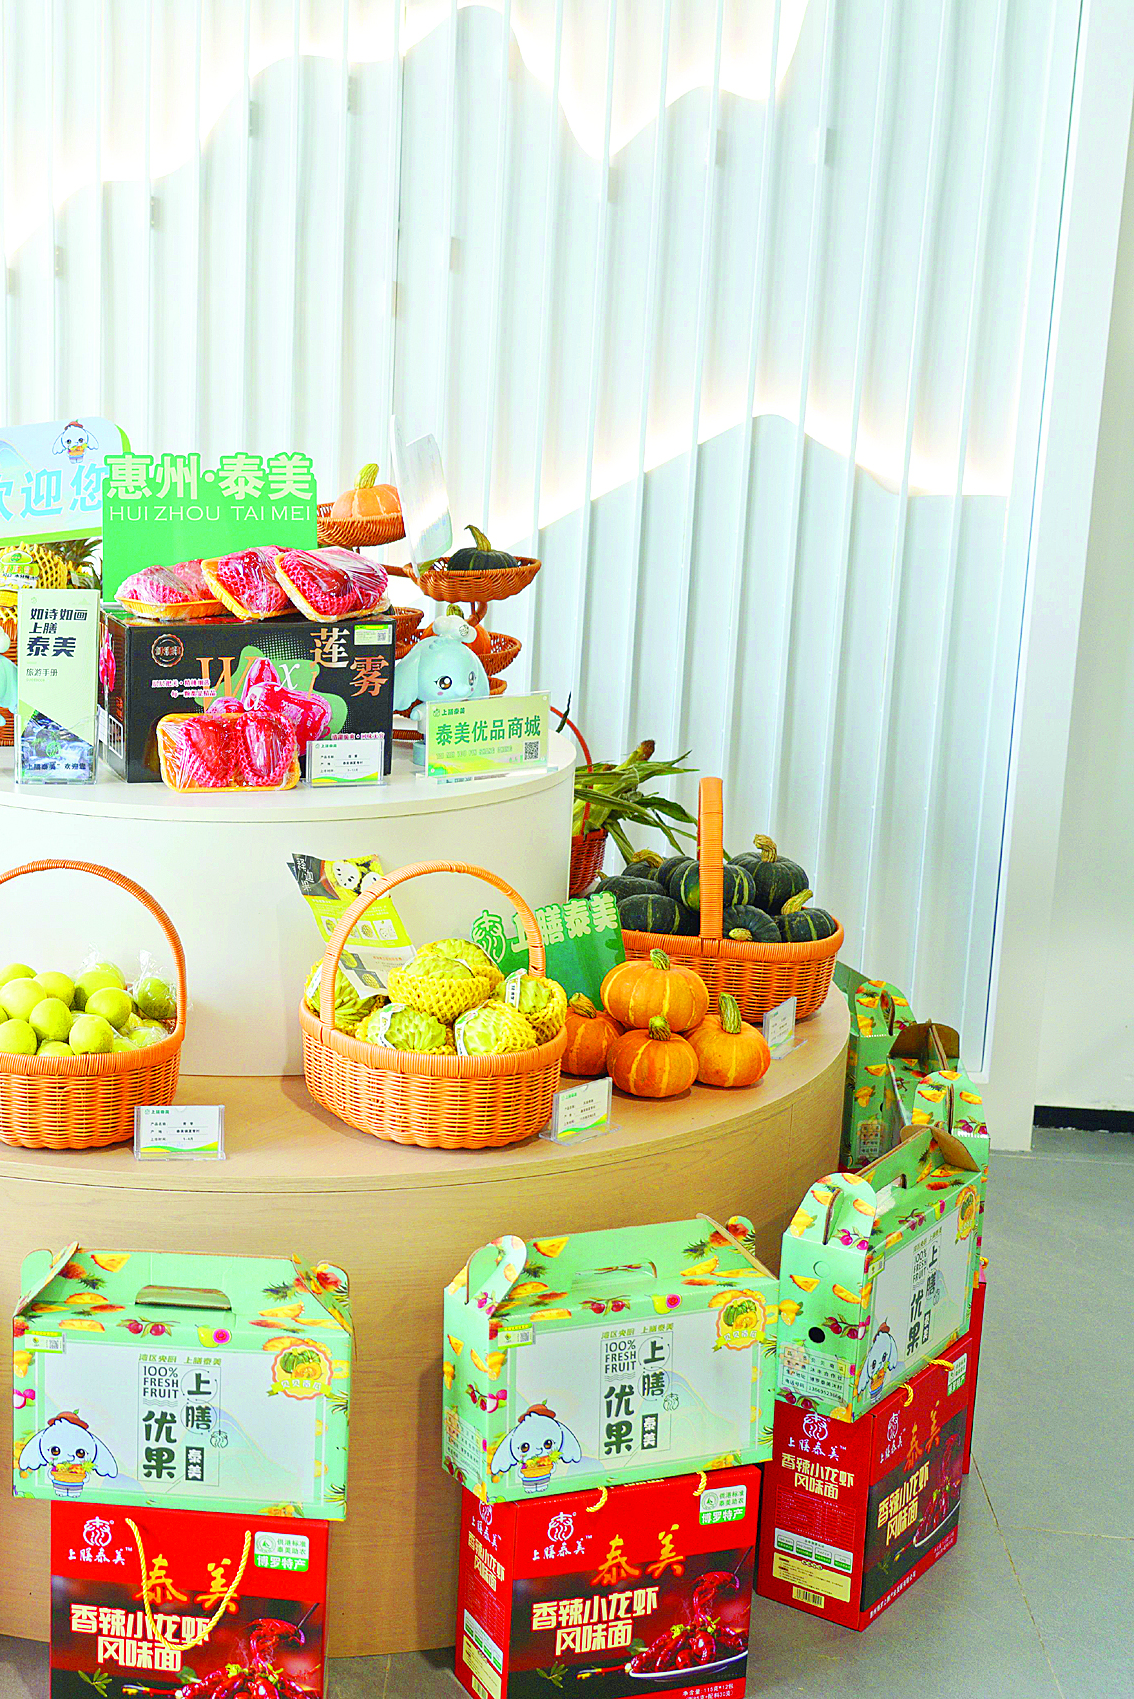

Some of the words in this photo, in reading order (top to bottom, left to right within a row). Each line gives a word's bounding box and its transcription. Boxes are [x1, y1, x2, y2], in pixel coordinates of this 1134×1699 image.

[106, 454, 314, 501] 惠州·泰美
[29, 622, 58, 634] 上膳
[30, 608, 88, 621] 如诗如画
[26, 636, 77, 658] 泰美
[310, 627, 390, 698] 莲雾
[435, 714, 541, 746] 泰美优品商城
[906, 1288, 924, 1356] 优果
[604, 1339, 636, 1354] 100%
[604, 1350, 637, 1363] FRESH
[142, 1365, 178, 1378] 100%
[143, 1377, 179, 1388] FRESH
[604, 1360, 637, 1374] FRUIT
[642, 1340, 666, 1397] 上膳
[143, 1386, 179, 1399] FRUIT
[185, 1372, 212, 1430] 上膳
[603, 1384, 635, 1456] 优果
[643, 1416, 656, 1448] 泰美
[142, 1410, 177, 1479] 优果
[788, 1436, 840, 1462] 上膳泰美
[187, 1448, 202, 1480] 泰美
[781, 1452, 855, 1488] 香辣小龙虾
[794, 1472, 839, 1500] 风味面
[877, 1460, 930, 1530] 香辣小龙虾
[702, 1508, 744, 1524] 博罗特产
[886, 1496, 919, 1547] 风味面
[68, 1546, 126, 1566] 上膳泰美
[257, 1555, 306, 1570] 博罗特产
[468, 1530, 506, 1582] 香辣小龙虾
[532, 1538, 586, 1561] 上膳泰美
[590, 1524, 686, 1588] 泰美
[132, 1553, 240, 1615] 泰美
[474, 1554, 496, 1592] 风味面
[70, 1603, 213, 1647] 香辣小龙虾
[531, 1585, 660, 1632] 香辣小龙虾
[96, 1635, 184, 1674] 风味面
[554, 1619, 633, 1656] 风味面
